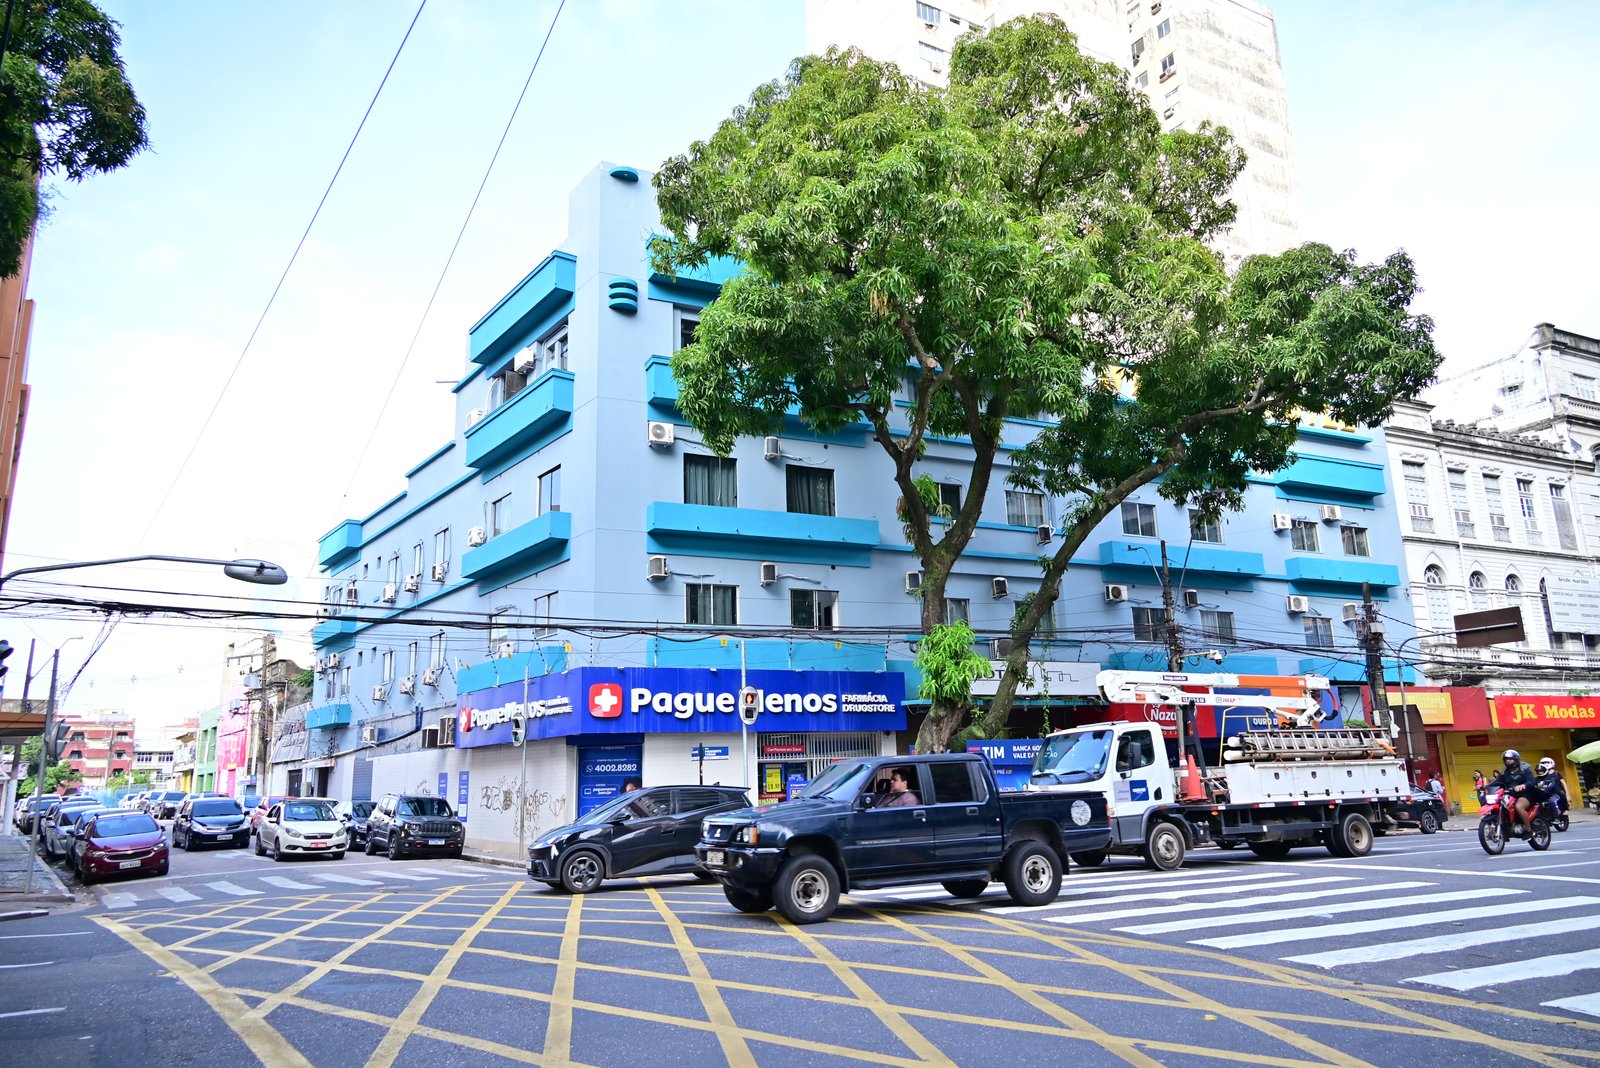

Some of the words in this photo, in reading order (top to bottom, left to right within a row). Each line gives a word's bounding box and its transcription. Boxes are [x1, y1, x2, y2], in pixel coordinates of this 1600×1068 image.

[631, 688, 735, 719] Pague
[842, 692, 889, 703] FARMÁCIA
[842, 704, 896, 713] DRUGSTORE
[1151, 708, 1177, 720] Naza
[1512, 703, 1538, 723] JK
[1543, 704, 1596, 719] Modas
[470, 707, 506, 731] Pague
[981, 746, 1005, 759] TIM
[594, 764, 637, 772] 4002.8282
